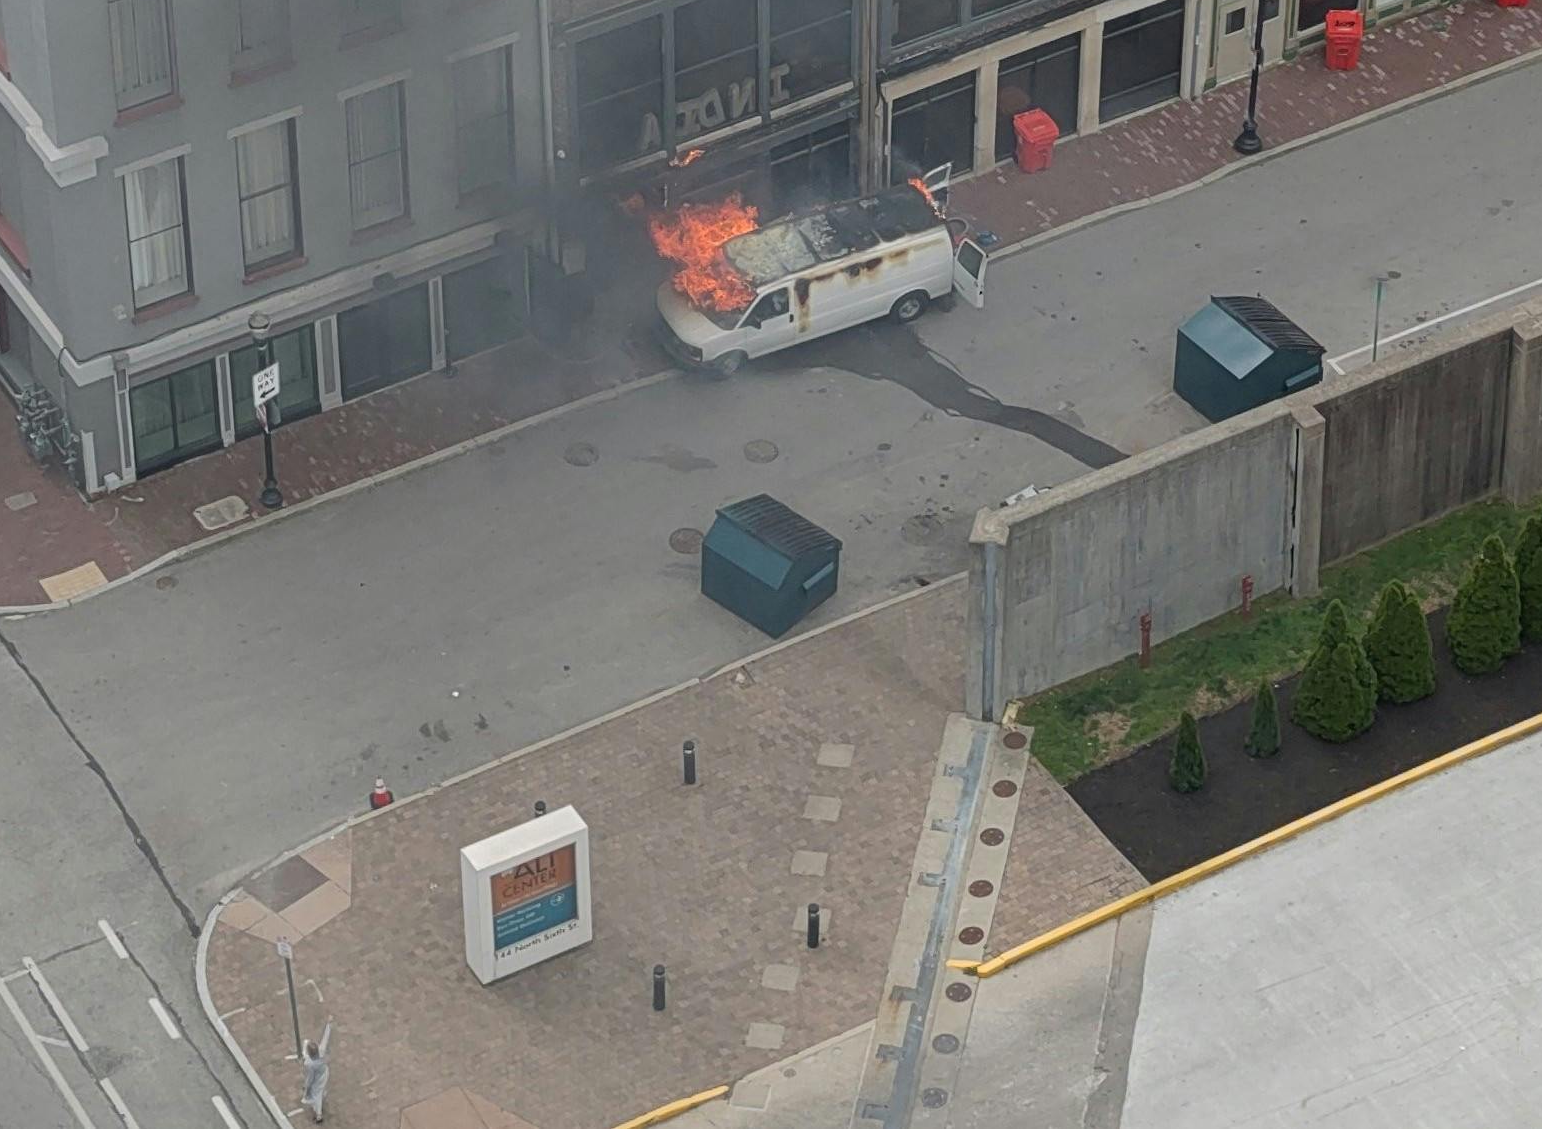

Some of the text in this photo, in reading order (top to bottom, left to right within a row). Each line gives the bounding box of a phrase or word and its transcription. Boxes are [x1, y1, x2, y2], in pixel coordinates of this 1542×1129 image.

[257, 368, 275, 383] ONE
[257, 376, 274, 390] WAY
[515, 853, 555, 879] ALI
[503, 868, 556, 898] CENTER
[515, 939, 541, 953] North
[544, 928, 566, 941] Sixth
